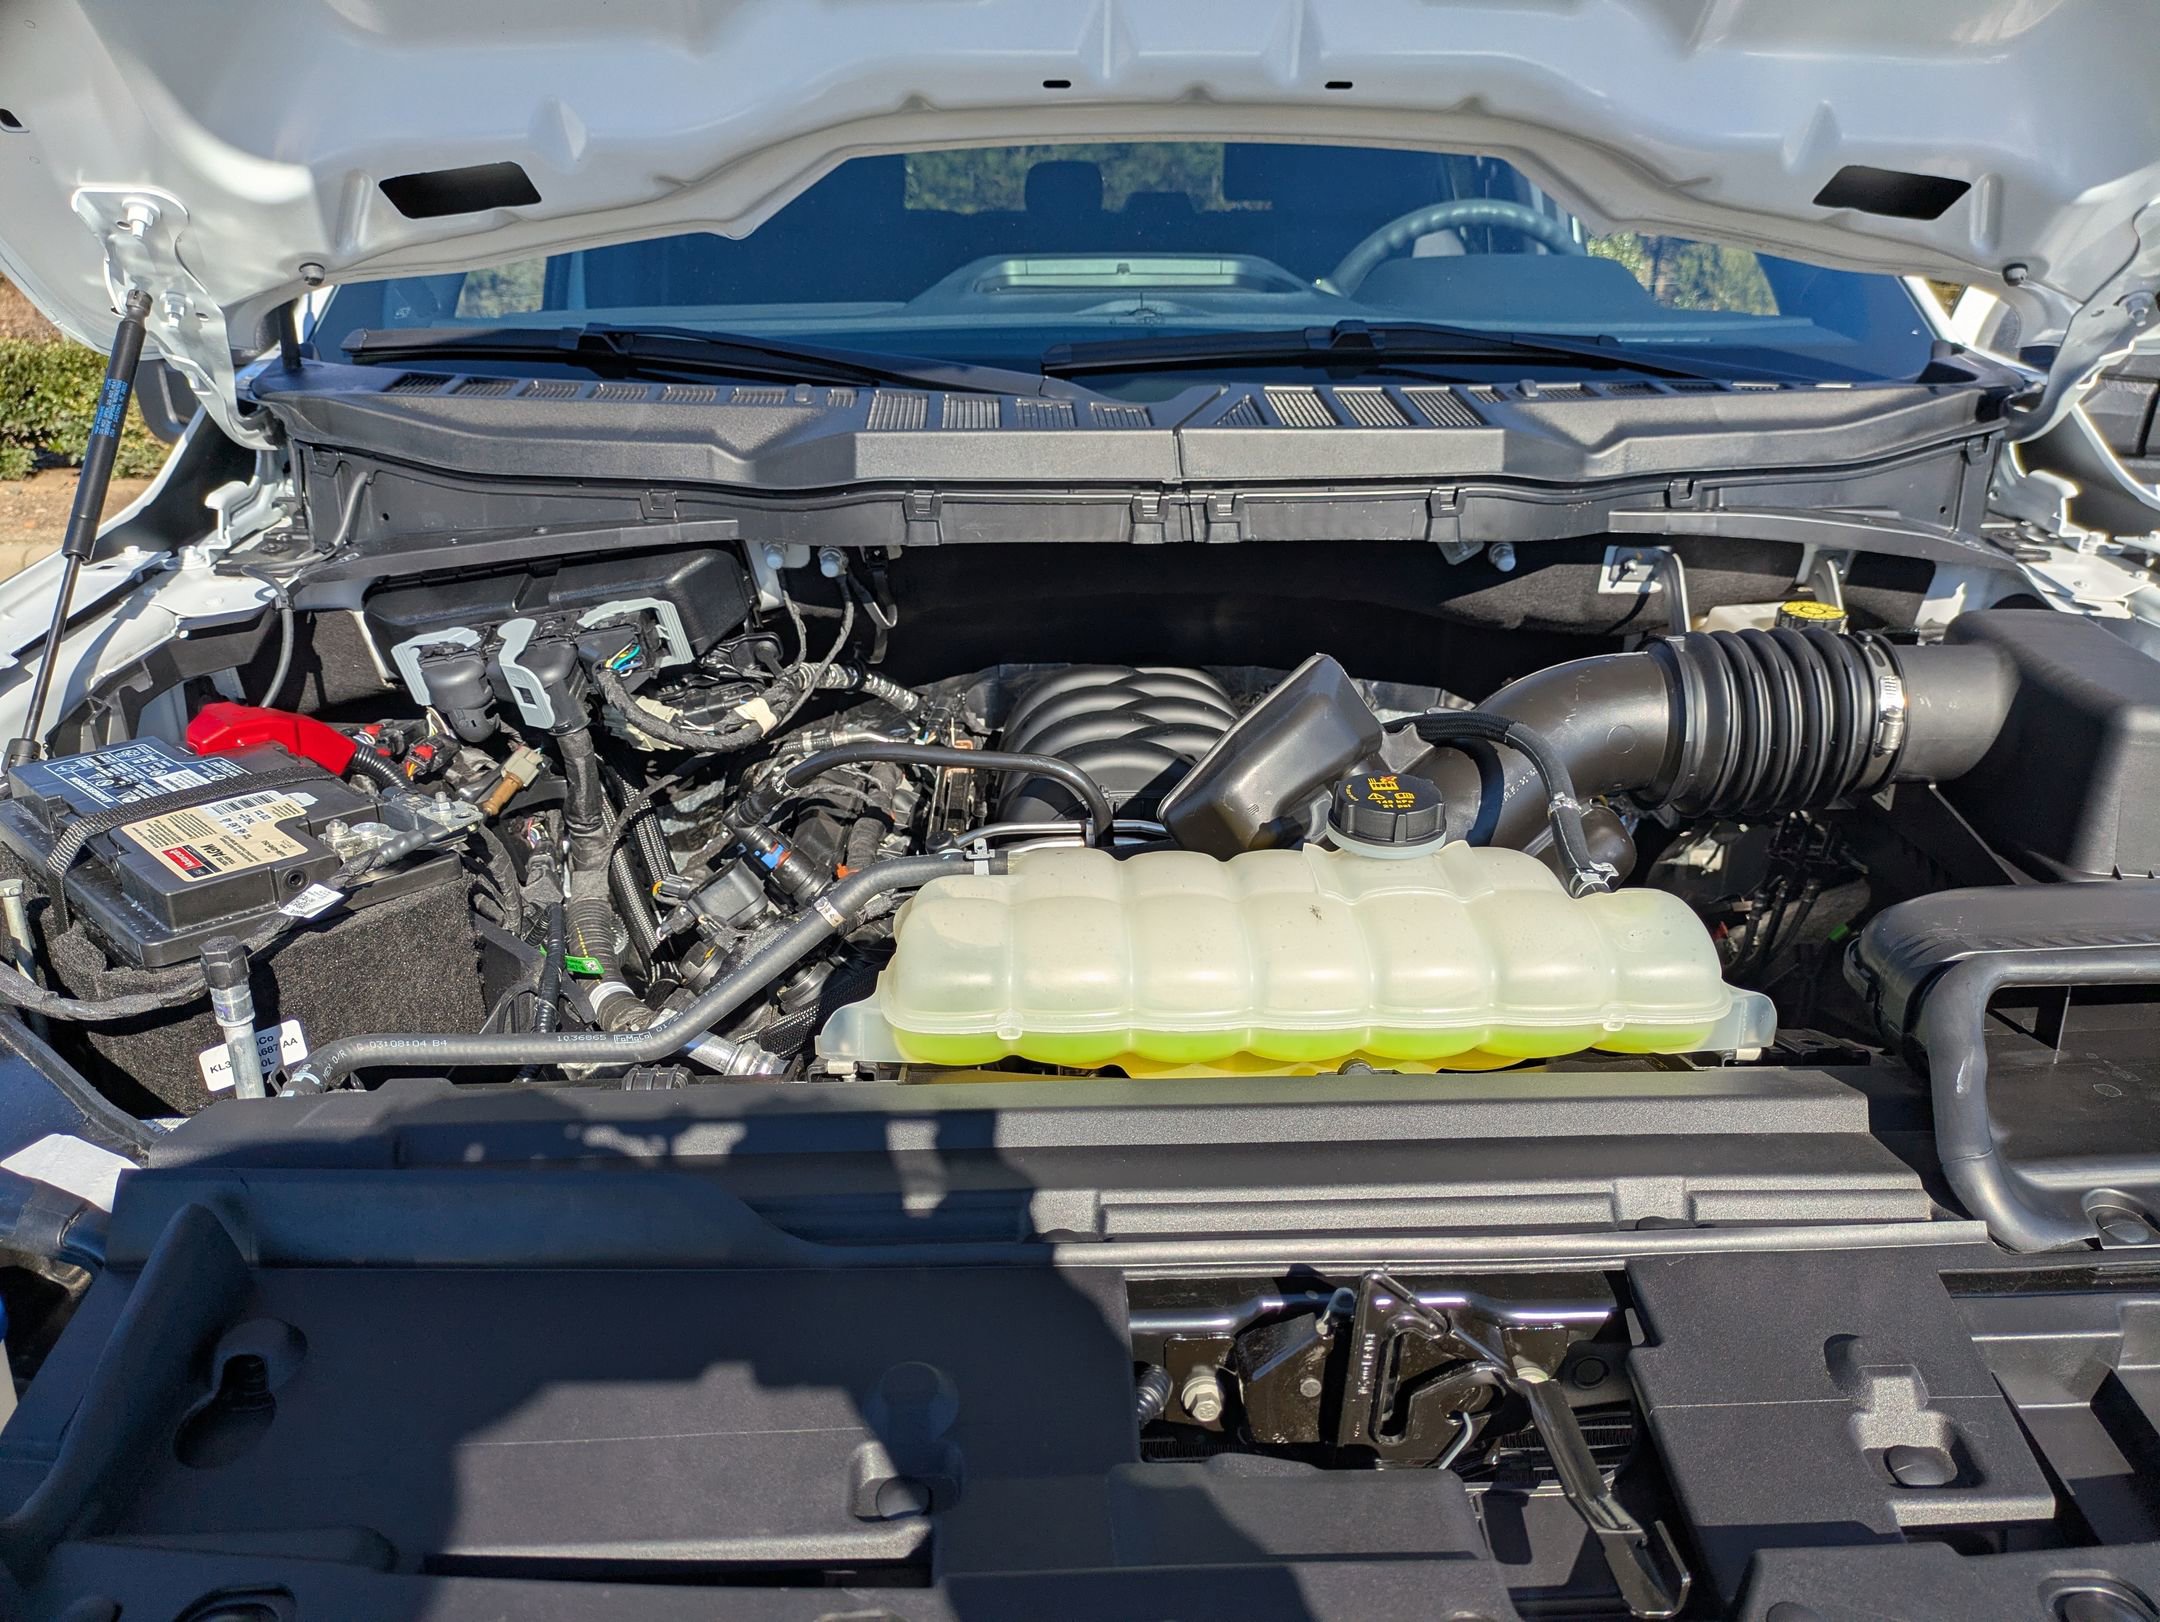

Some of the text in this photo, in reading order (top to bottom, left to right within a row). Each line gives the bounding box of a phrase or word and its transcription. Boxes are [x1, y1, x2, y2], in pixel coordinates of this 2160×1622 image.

[282, 1037, 298, 1048] AA
[615, 1032, 650, 1043] FoMoCo
[369, 1039, 426, 1048] 03:08:04
